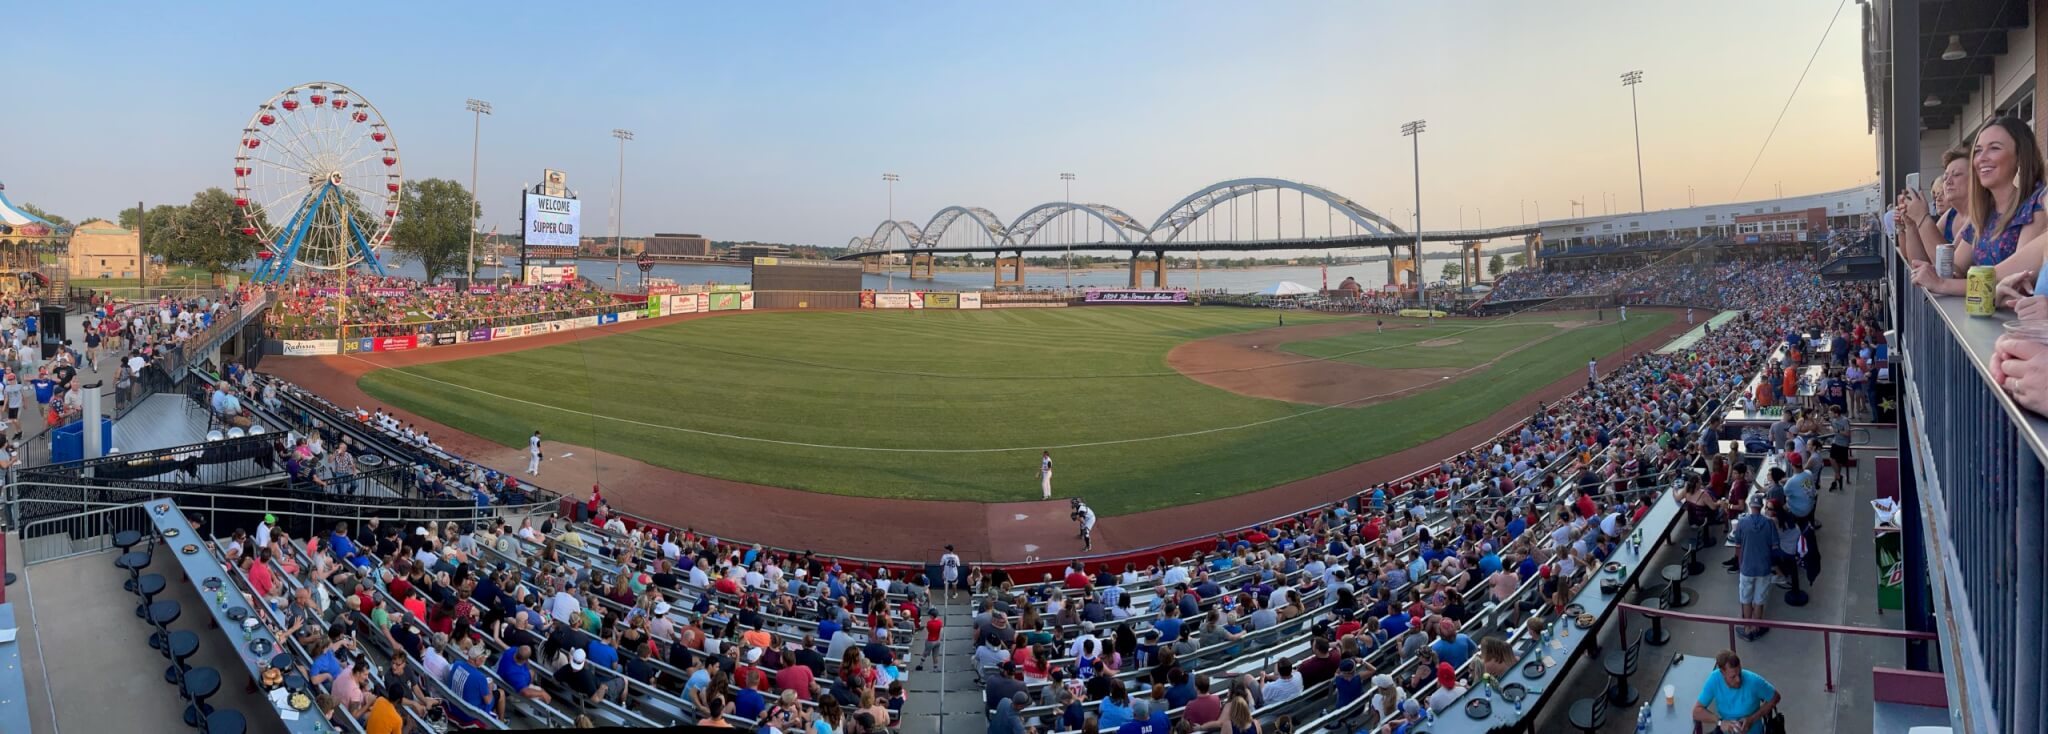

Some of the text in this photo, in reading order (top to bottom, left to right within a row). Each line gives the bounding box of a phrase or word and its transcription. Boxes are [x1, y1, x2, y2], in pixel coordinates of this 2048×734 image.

[538, 198, 570, 212] WELCOME
[533, 220, 573, 234] SUPPER CLUB
